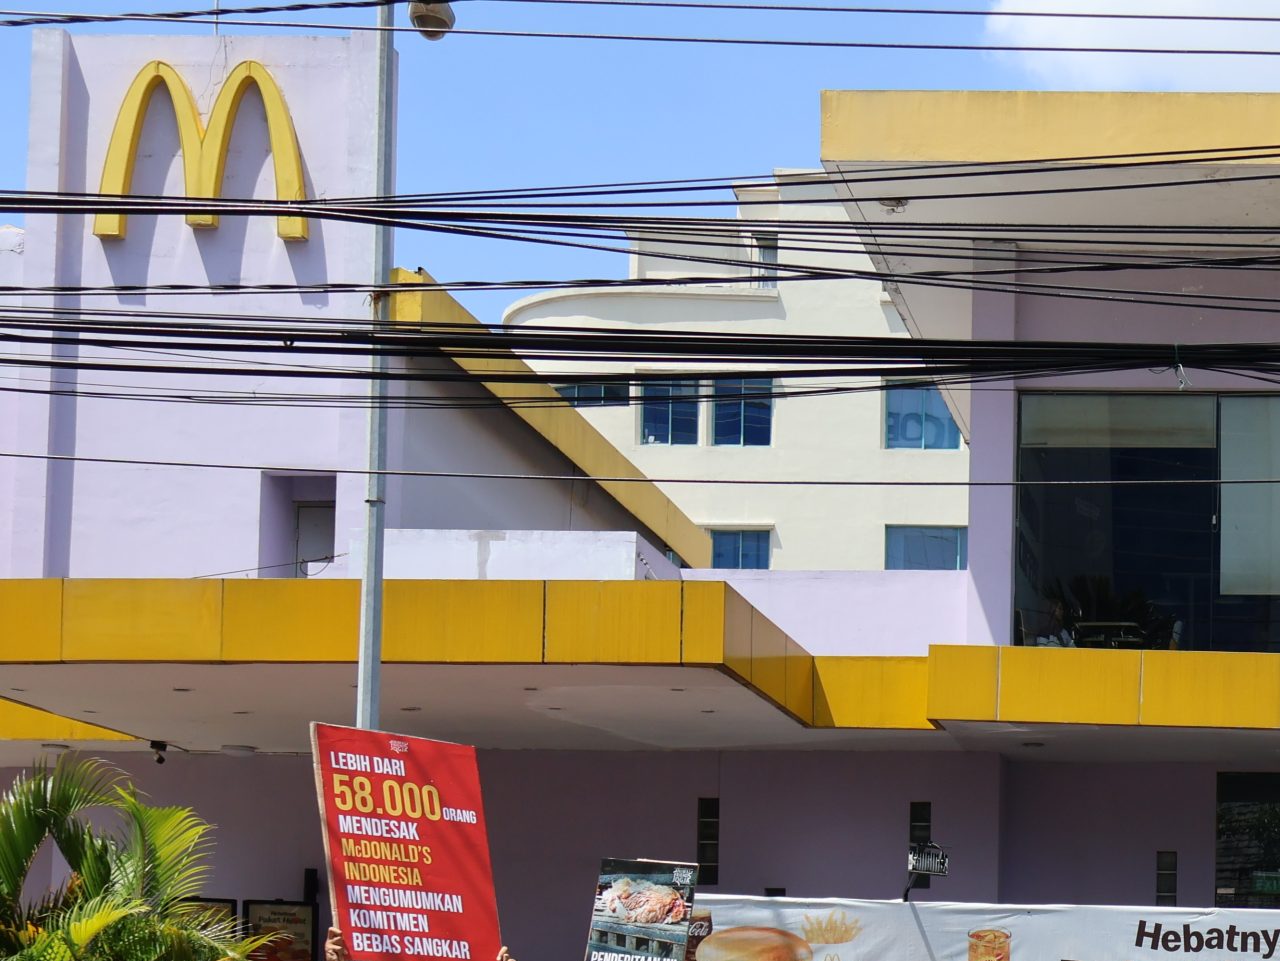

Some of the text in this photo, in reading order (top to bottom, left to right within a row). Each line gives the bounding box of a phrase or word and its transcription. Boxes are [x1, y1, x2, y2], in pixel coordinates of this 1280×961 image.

[330, 751, 405, 777] LEBIH DARI
[332, 773, 477, 825] 58.000 ORANG
[338, 814, 420, 841] MENDESAK
[341, 838, 433, 865] McDONALD'S
[344, 861, 423, 887] INDONESIA
[346, 884, 464, 914] MENGUMUMKAN
[349, 908, 429, 933] KOMITMEN
[352, 931, 471, 960] BEBAS SANGKAR
